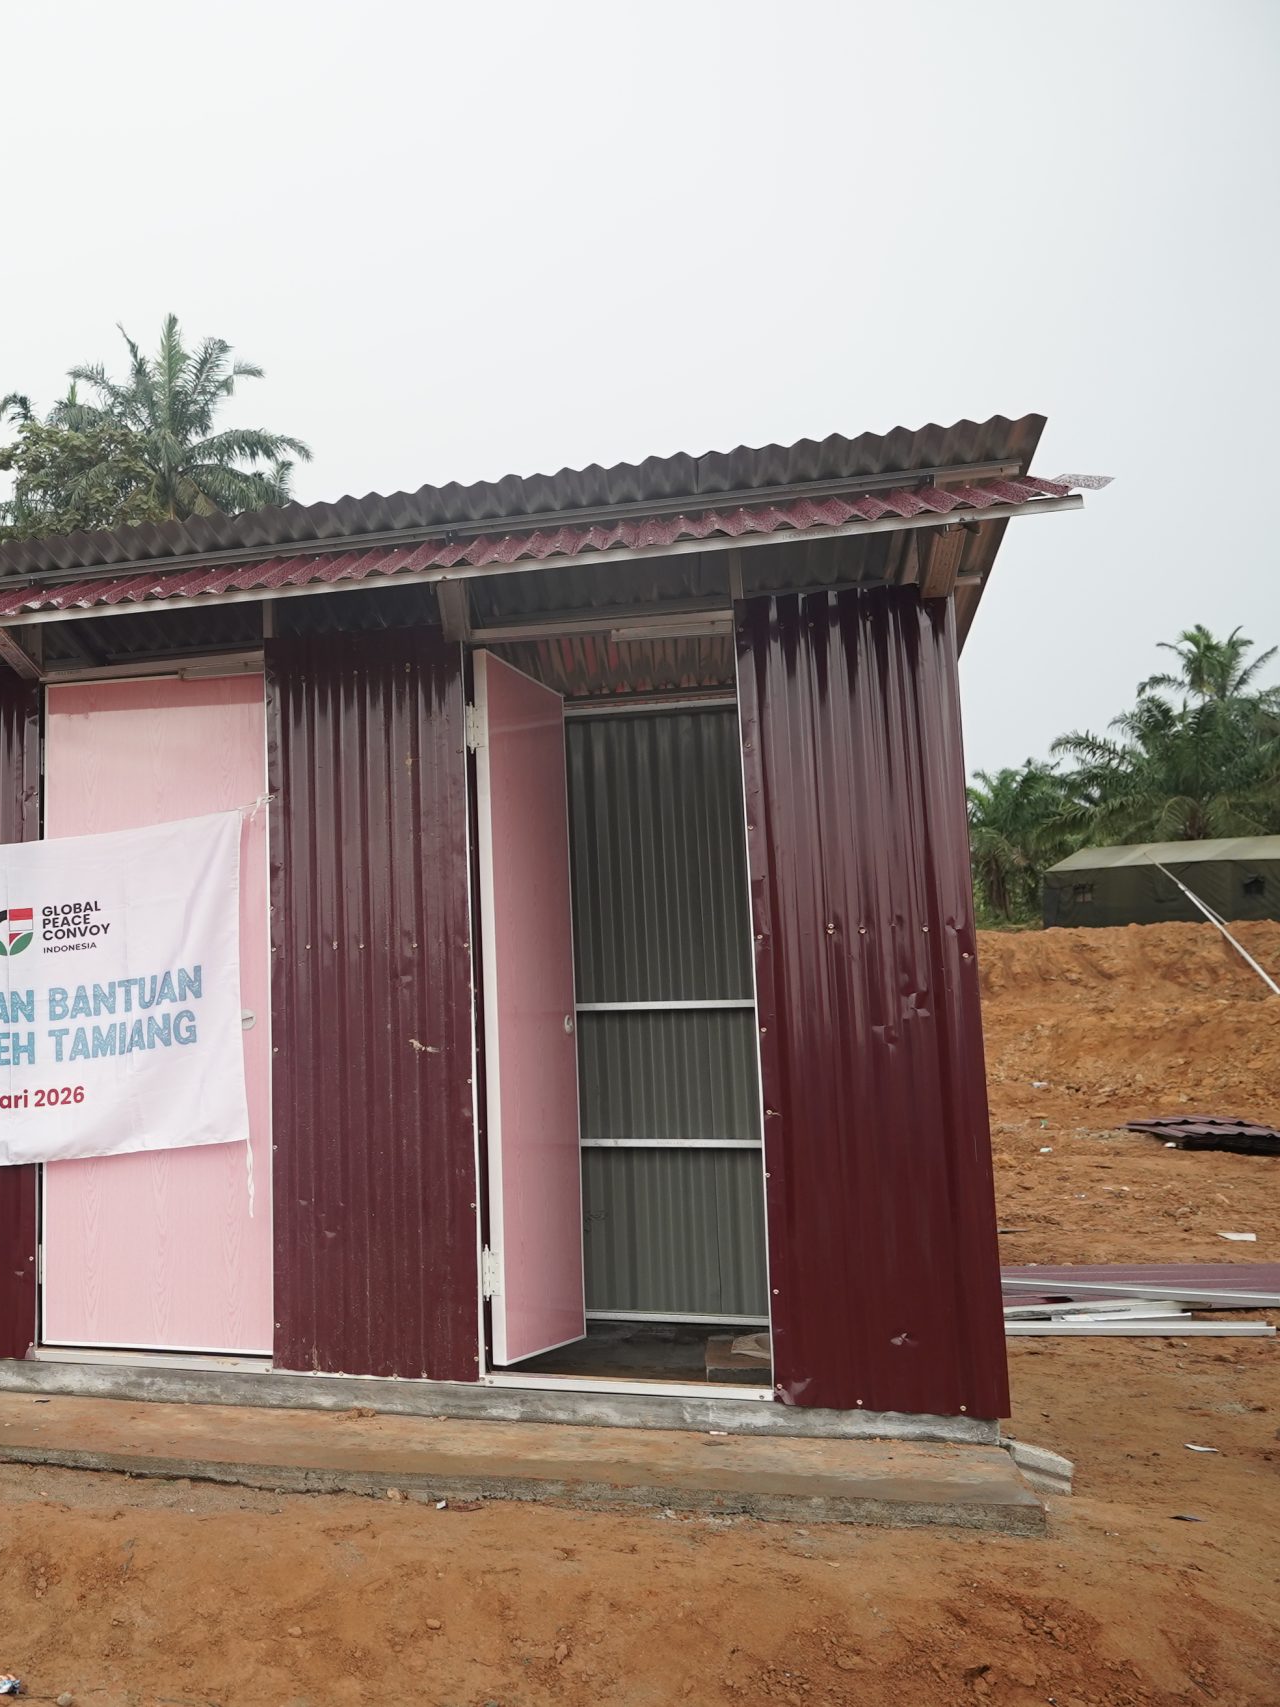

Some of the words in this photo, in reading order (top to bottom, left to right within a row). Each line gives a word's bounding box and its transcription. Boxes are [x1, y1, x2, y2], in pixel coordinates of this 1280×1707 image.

[42, 900, 101, 917] GLOBAL
[42, 913, 91, 929] PEACE
[42, 923, 111, 941] CONVOY
[43, 942, 97, 954] INDONESIA
[48, 964, 203, 1021] BANTUAN
[48, 1009, 198, 1063] TAMIANG
[34, 1086, 85, 1108] 2026
